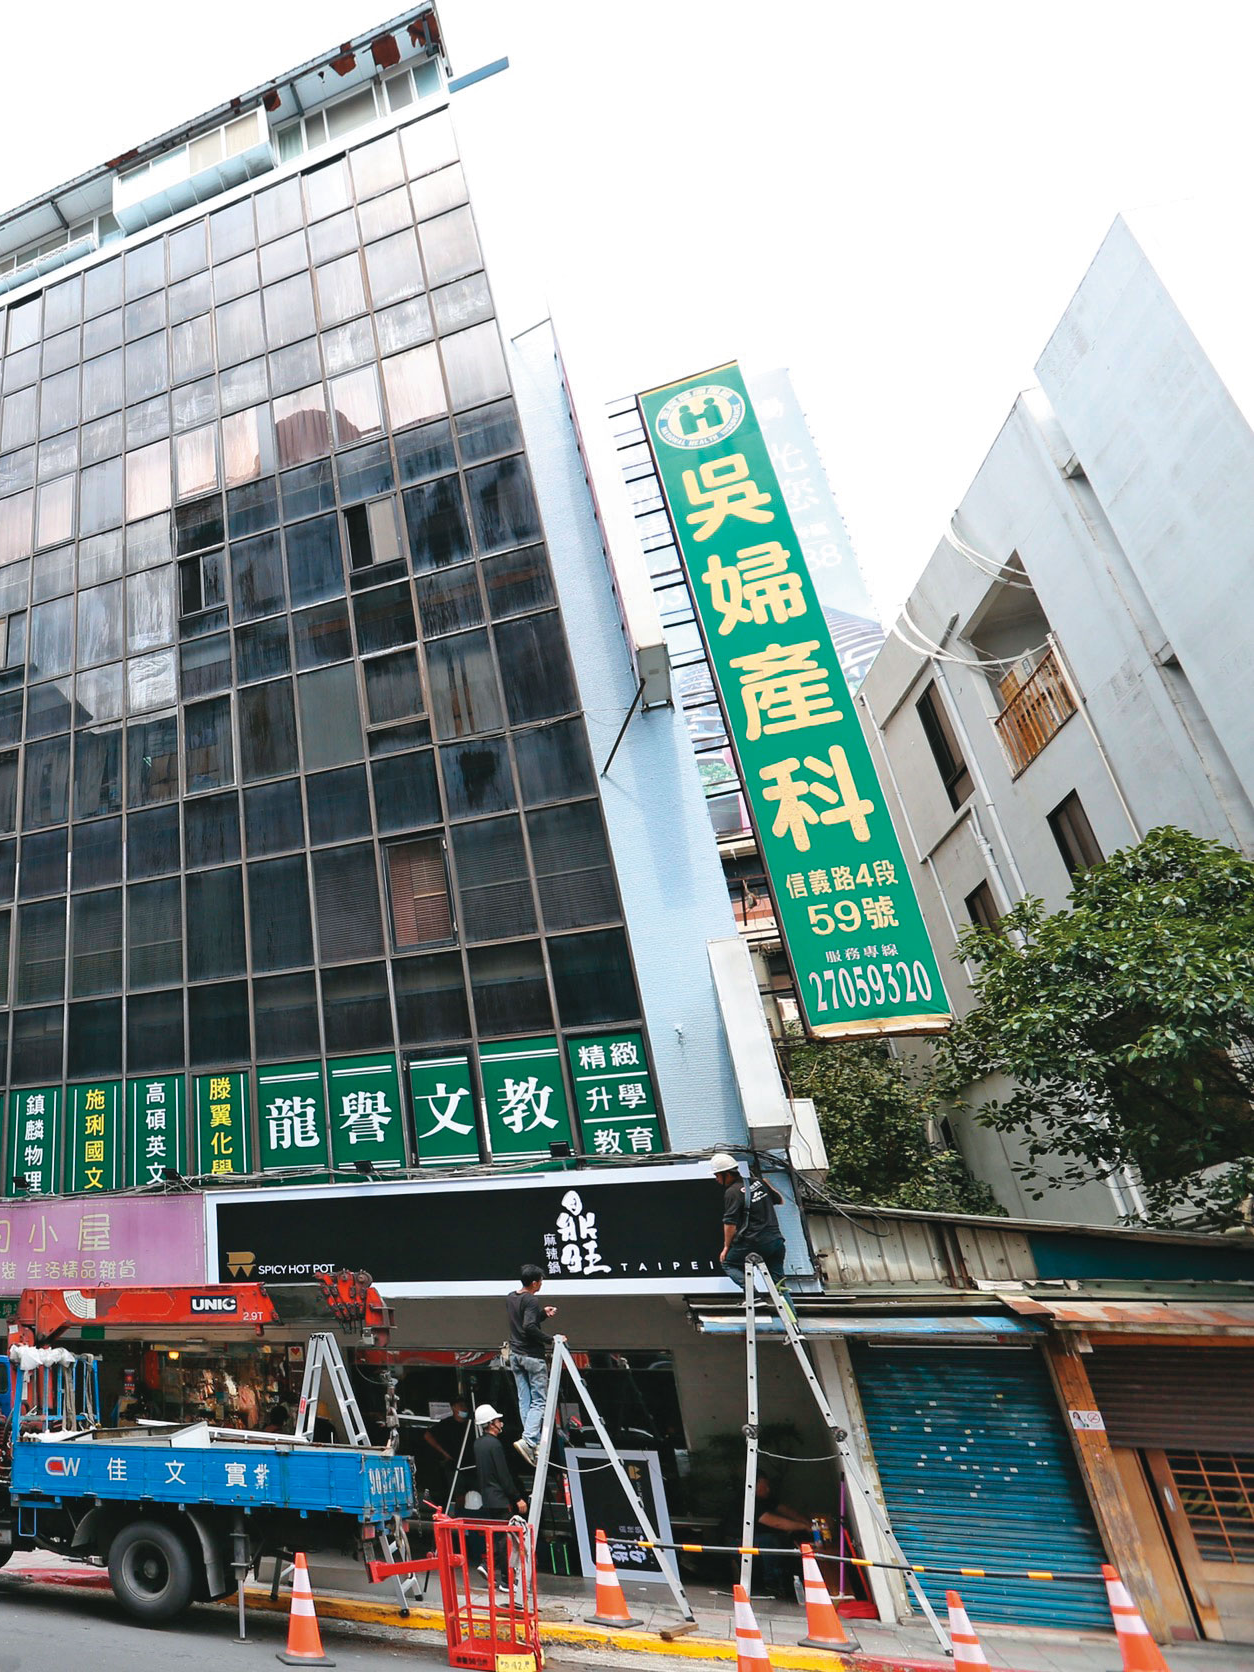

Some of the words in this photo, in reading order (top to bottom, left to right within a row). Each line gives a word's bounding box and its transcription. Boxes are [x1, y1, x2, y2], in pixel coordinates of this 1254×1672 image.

[681, 453, 874, 853] 吳婦產科
[786, 860, 898, 899] 信義路4段
[807, 896, 899, 935] 59號
[825, 944, 899, 963] 服務專線
[808, 960, 933, 1012] 27059320
[578, 1041, 640, 1069] 精緻
[586, 1083, 647, 1112] 升學
[265, 1076, 560, 1151] 龍譽文教
[145, 1082, 167, 1185] 高碩英文
[593, 1126, 654, 1154] 教育
[543, 1233, 562, 1275] 麻辣鍋
[620, 1260, 715, 1272] TAIPEI
[26, 1259, 136, 1280] 生活精品雜貨
[258, 1264, 288, 1275] SPICY
[288, 1264, 311, 1274] HOT
[312, 1263, 335, 1274] POT
[191, 1298, 237, 1311] UNIC
[243, 1311, 264, 1321] 2.9T
[106, 1457, 270, 1490] 佳文實業
